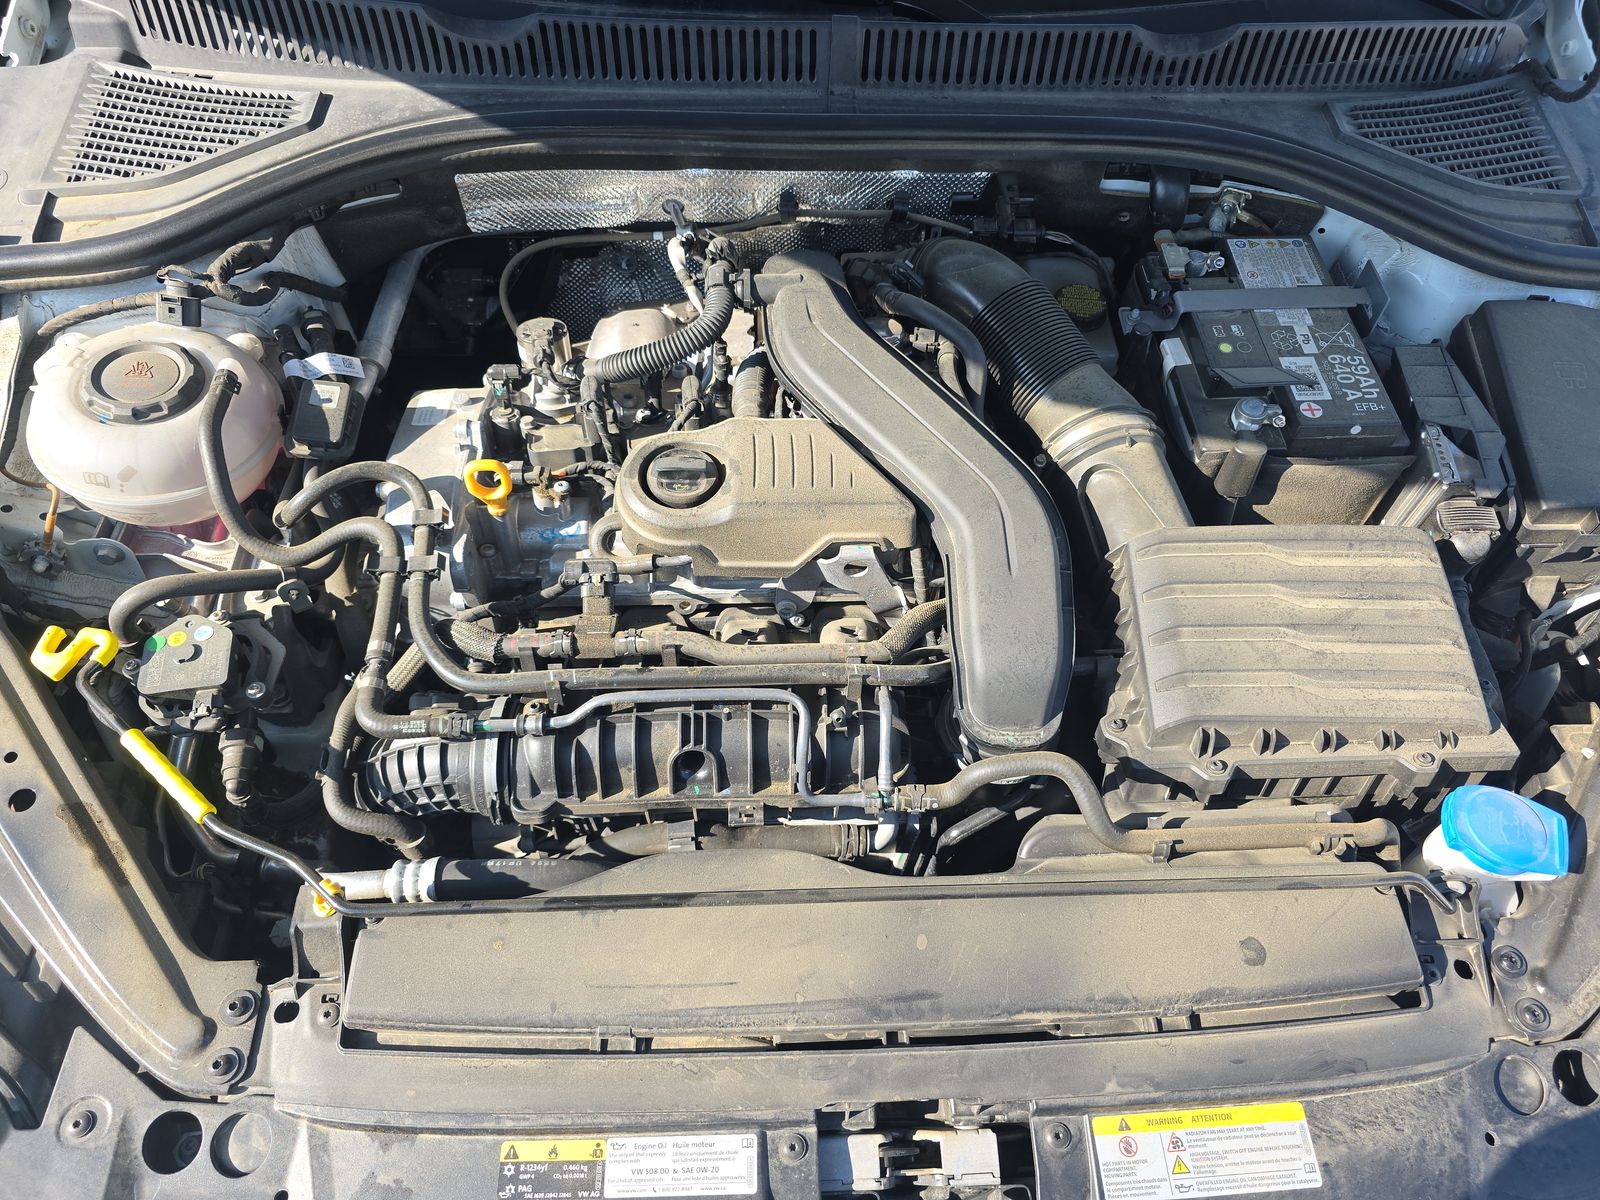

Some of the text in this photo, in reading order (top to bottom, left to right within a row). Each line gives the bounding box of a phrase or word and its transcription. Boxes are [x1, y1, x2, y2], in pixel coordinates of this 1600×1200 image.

[1300, 333, 1310, 344] Pb
[1328, 354, 1356, 384] 640
[1342, 388, 1363, 401] A
[1347, 356, 1380, 398] 59Ah
[1354, 402, 1386, 411] EFB+
[1146, 1113, 1232, 1126] WARNING ATTENTION
[634, 1142, 656, 1150] Engine
[520, 1162, 548, 1172] R-1234yf
[581, 1164, 588, 1172] kg
[518, 1184, 532, 1192] PAG
